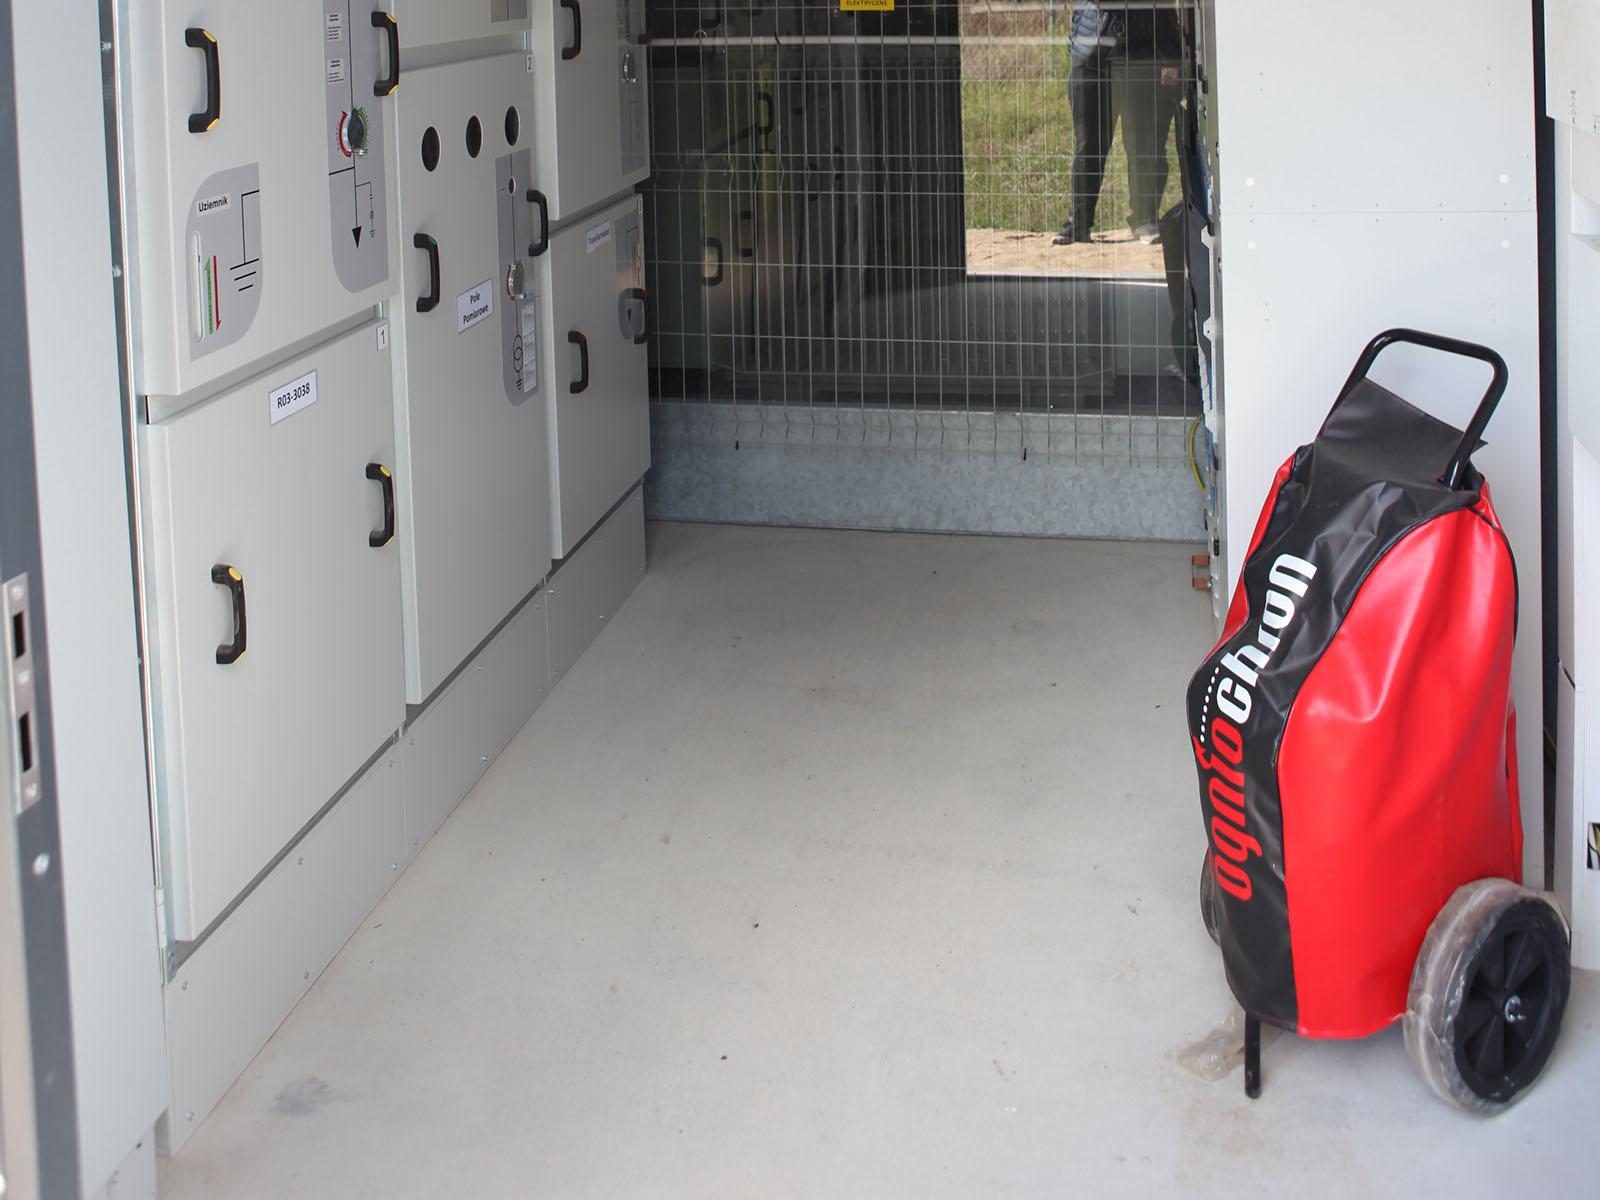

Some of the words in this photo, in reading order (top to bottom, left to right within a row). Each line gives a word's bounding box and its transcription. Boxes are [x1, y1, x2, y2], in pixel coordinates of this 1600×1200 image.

[199, 196, 228, 212] Uziemnik
[469, 291, 481, 305] Pole
[277, 382, 311, 409] R03-3038
